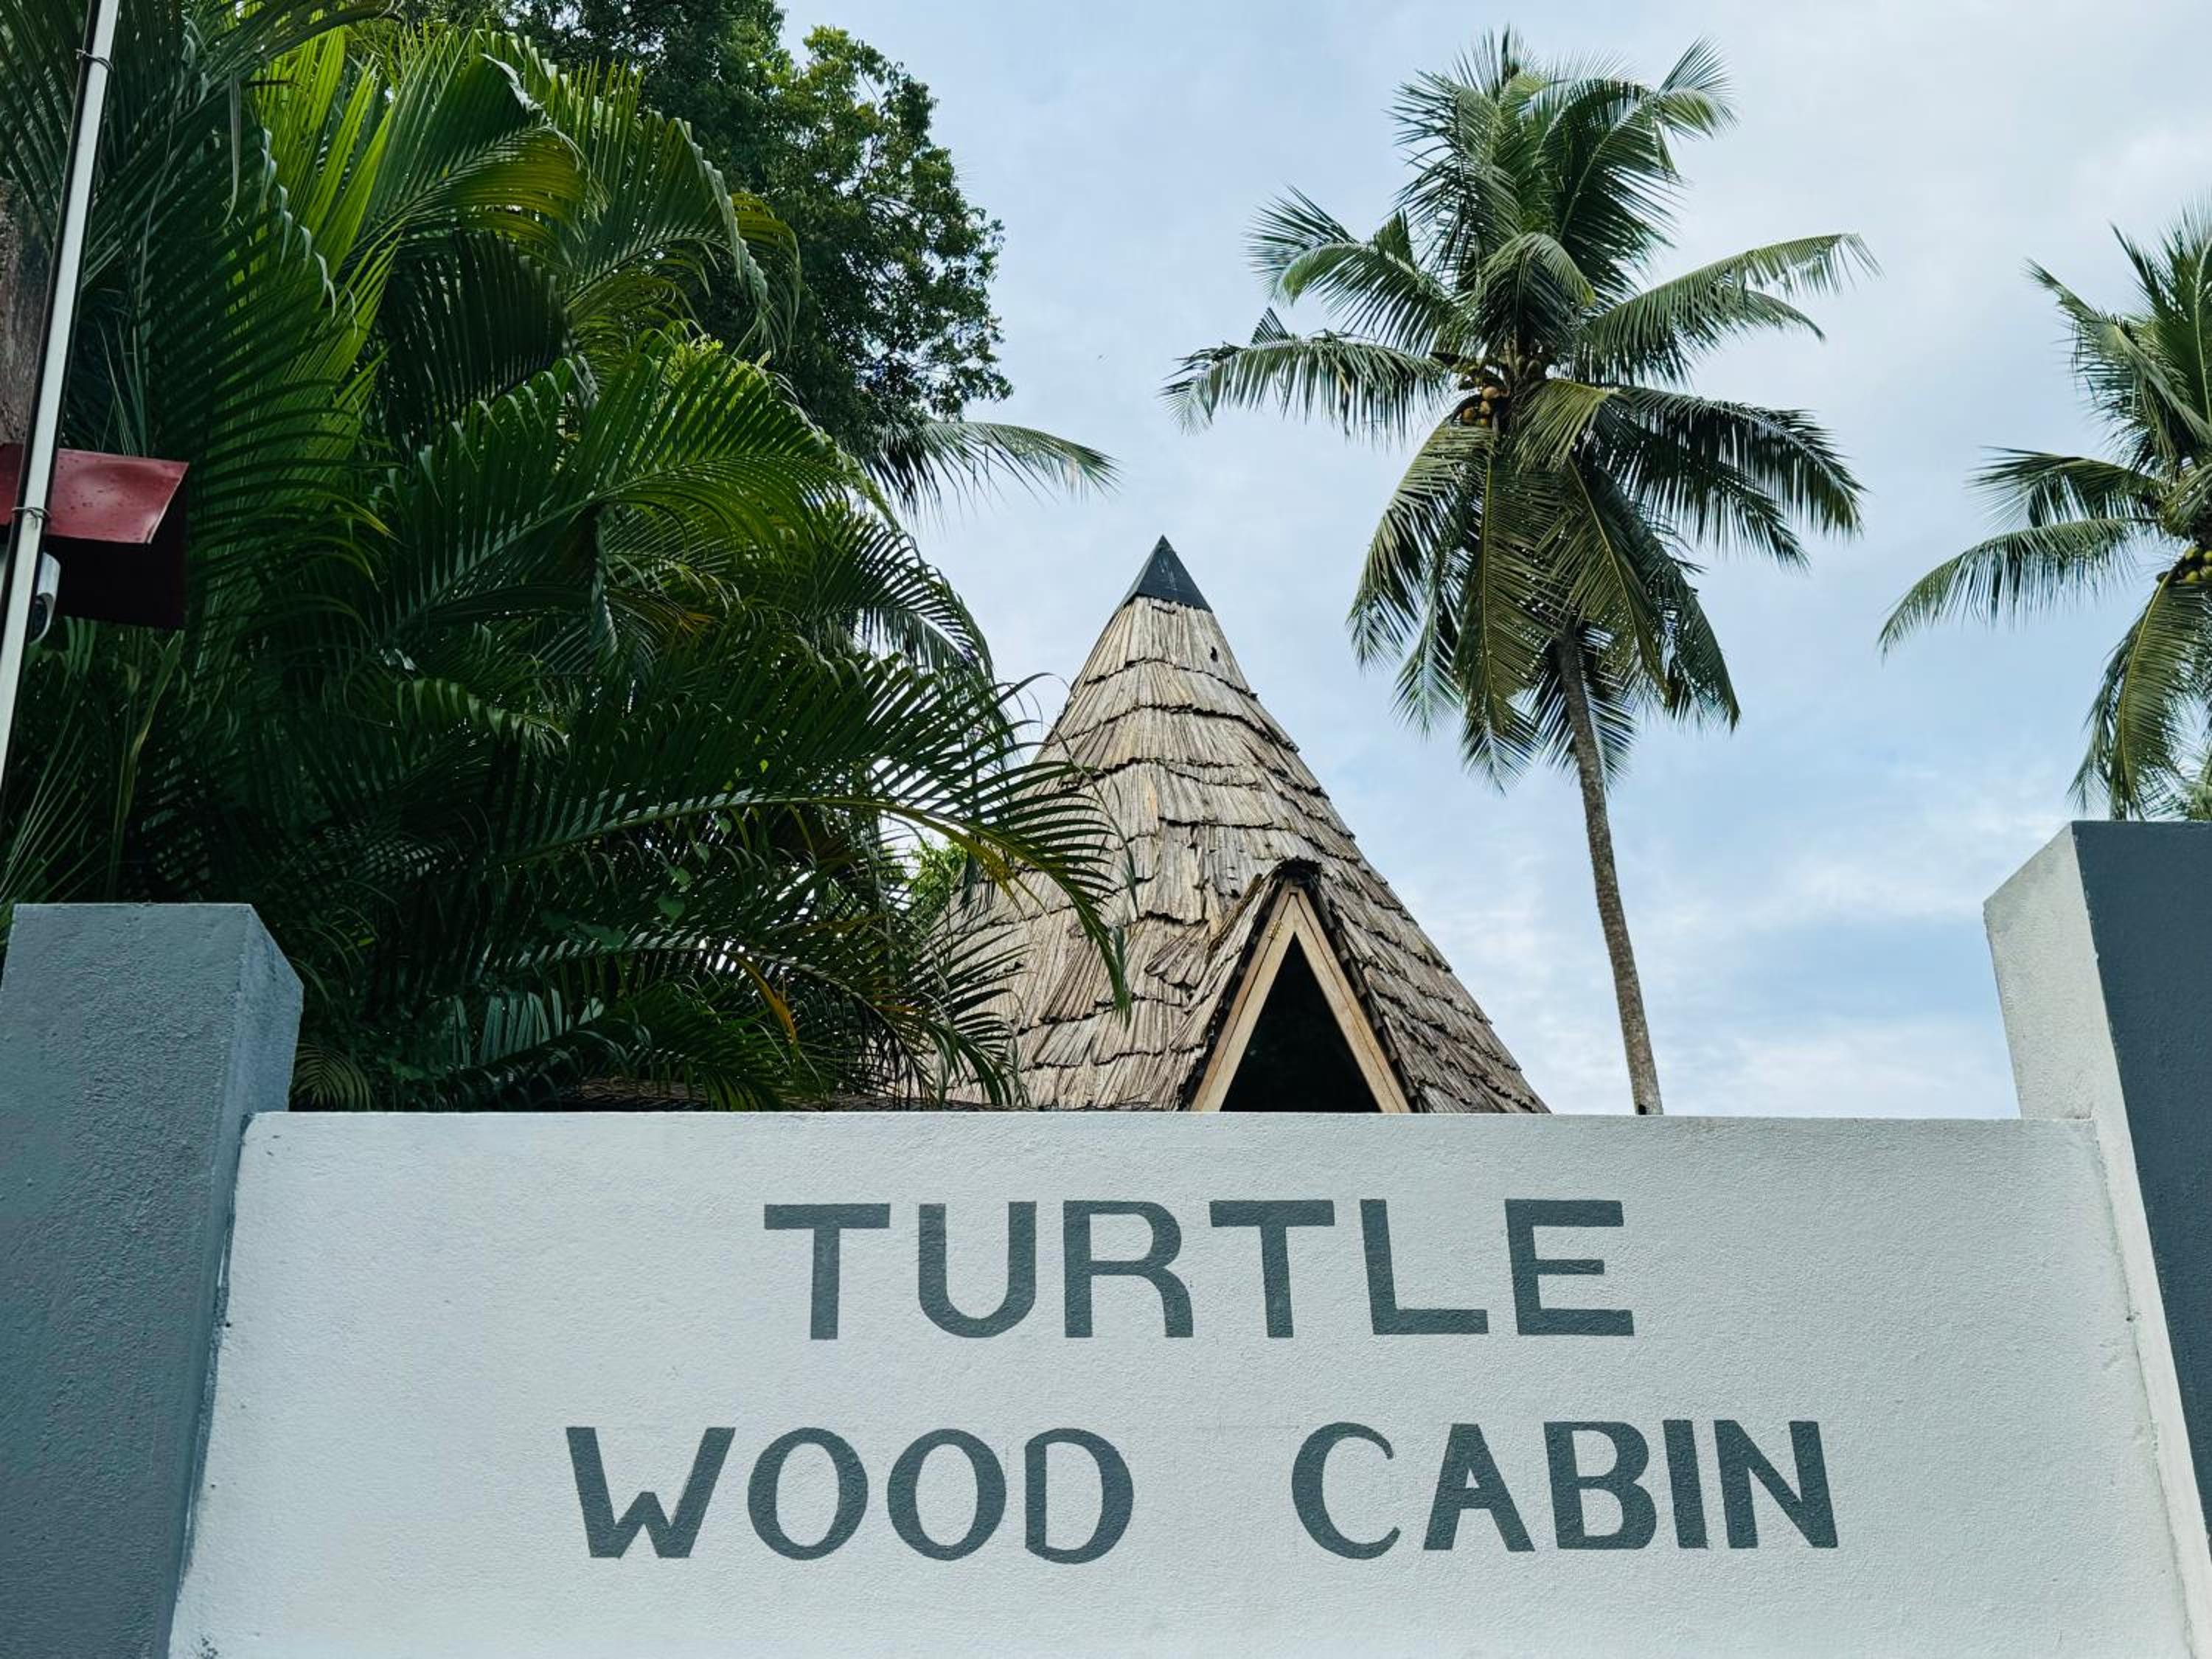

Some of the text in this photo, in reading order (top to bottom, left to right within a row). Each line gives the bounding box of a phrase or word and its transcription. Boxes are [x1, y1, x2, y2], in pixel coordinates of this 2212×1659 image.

[764, 1198, 1635, 1340] TURTLE
[566, 1419, 1838, 1565] WOOD CABIN
